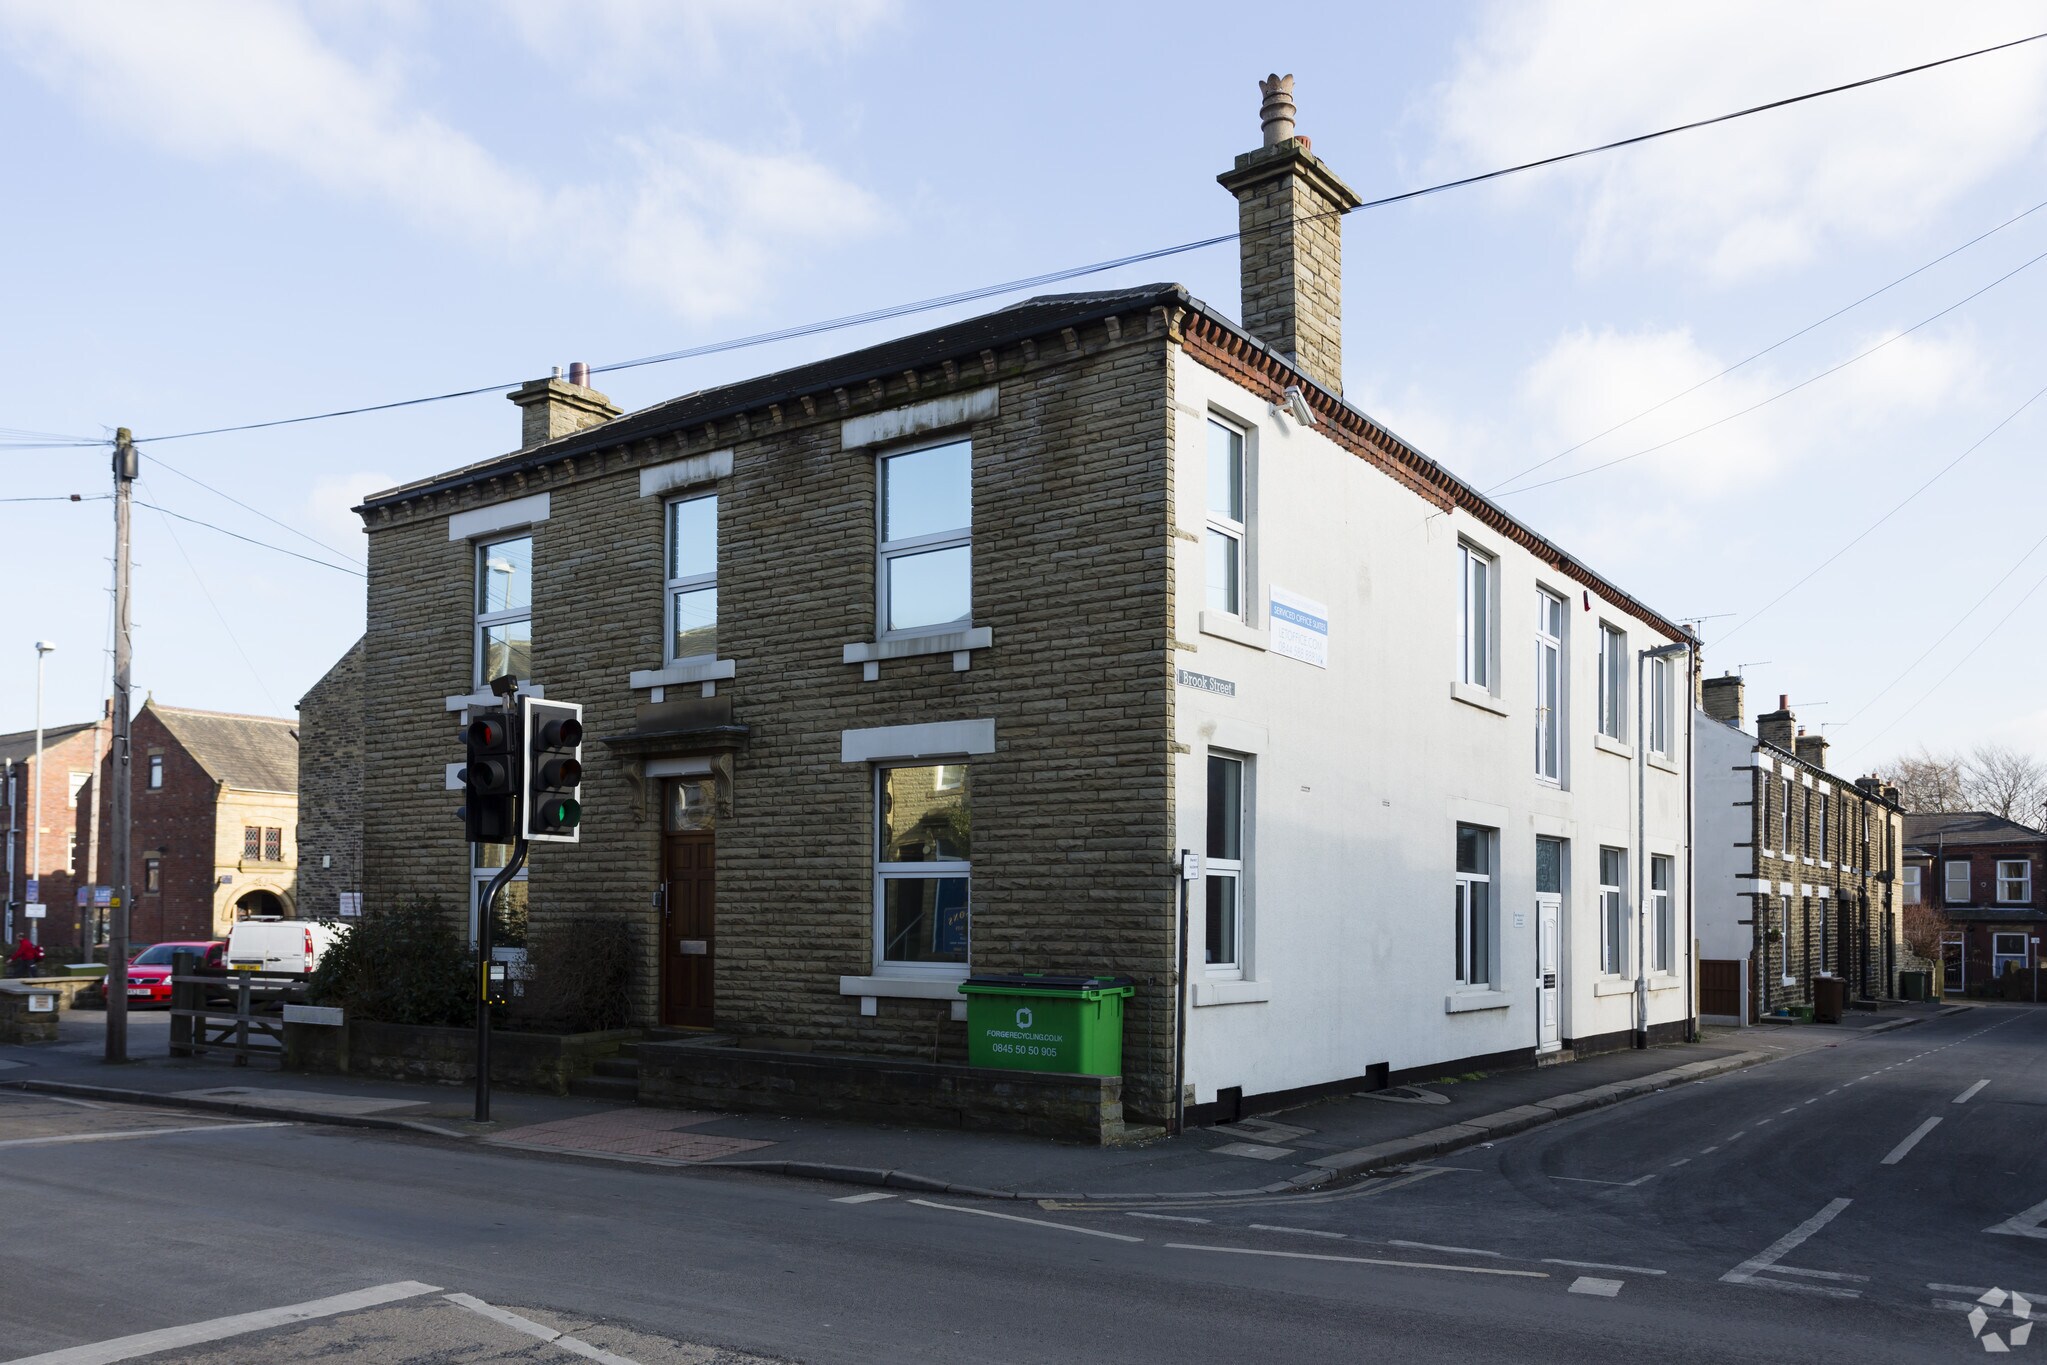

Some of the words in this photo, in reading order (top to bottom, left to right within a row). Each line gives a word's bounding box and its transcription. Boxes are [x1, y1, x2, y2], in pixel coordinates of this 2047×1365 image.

[1273, 605, 1295, 621] SERVICED
[1296, 614, 1312, 627] OFFICE
[1312, 619, 1327, 632] SUITES
[1182, 671, 1207, 689] Brook
[1209, 677, 1232, 695] Street
[992, 1043, 1013, 1054] 0845
[1015, 1045, 1026, 1054] 50
[1028, 1046, 1039, 1056] 50
[1041, 1047, 1057, 1057] 905
